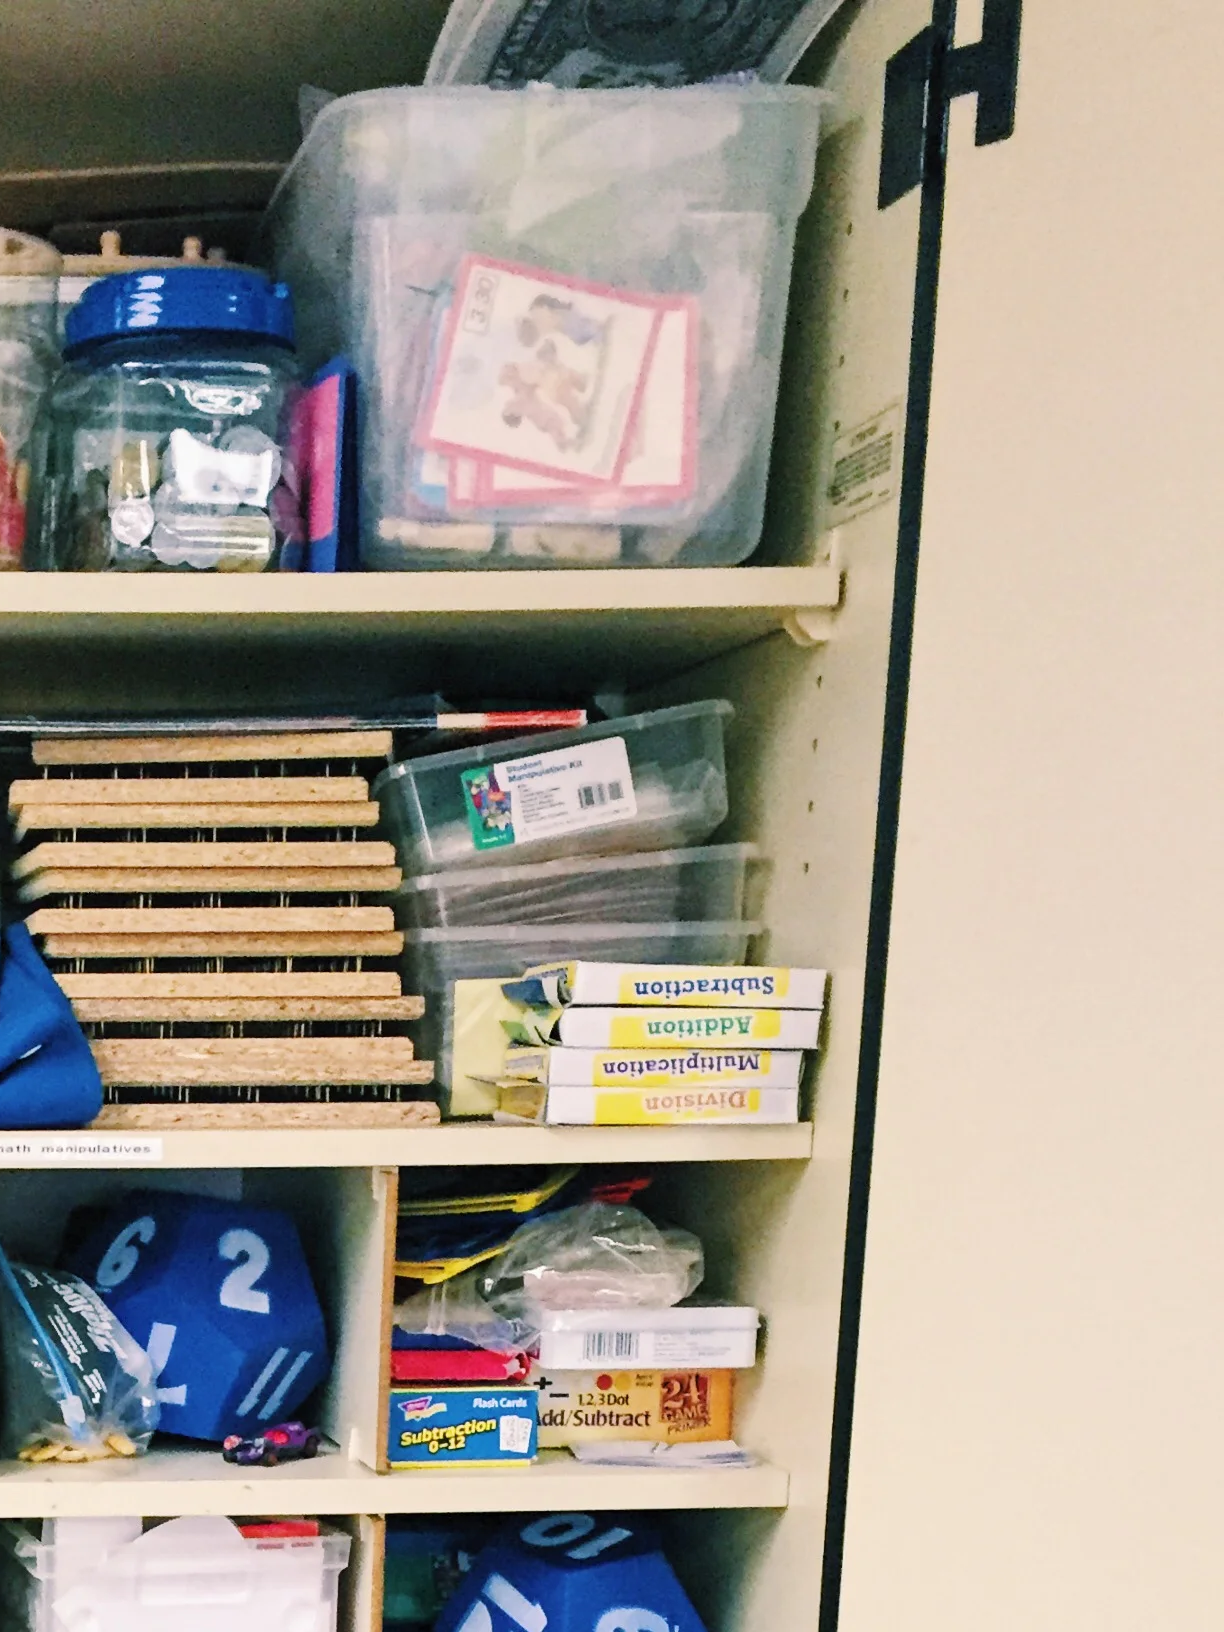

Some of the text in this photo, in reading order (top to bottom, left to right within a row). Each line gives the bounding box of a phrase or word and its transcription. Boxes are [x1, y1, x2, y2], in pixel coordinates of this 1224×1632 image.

[634, 976, 774, 998] Subtraction
[647, 1016, 753, 1037] Addition
[603, 1054, 761, 1077] Multiplication
[645, 1091, 748, 1112] Division
[41, 1144, 151, 1155] manipulatives
[96, 1215, 156, 1287] 6
[218, 1228, 270, 1315] 2
[235, 1347, 313, 1421] 11
[662, 1374, 701, 1409] 24
[473, 1398, 528, 1409] Flash Cards
[607, 1393, 629, 1406] Dot
[400, 1418, 497, 1447] Subtraction
[520, 1513, 633, 1559] 10
